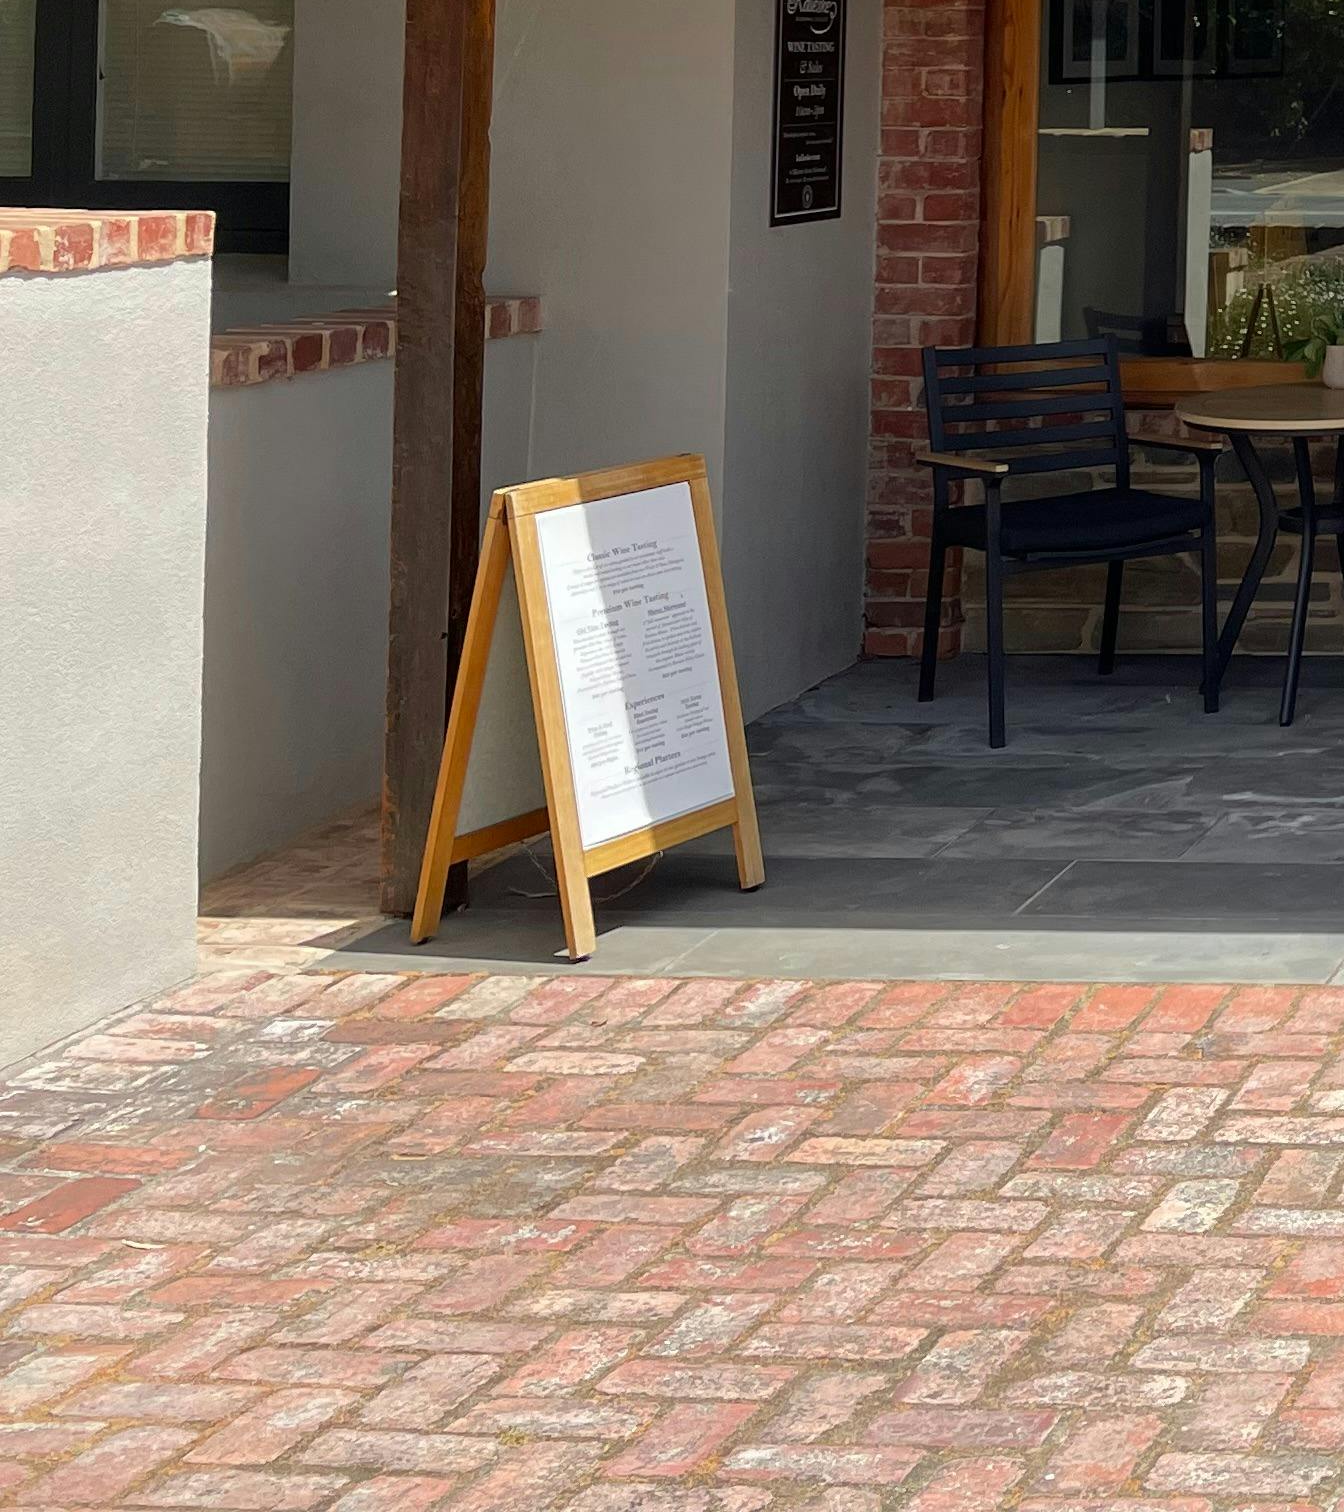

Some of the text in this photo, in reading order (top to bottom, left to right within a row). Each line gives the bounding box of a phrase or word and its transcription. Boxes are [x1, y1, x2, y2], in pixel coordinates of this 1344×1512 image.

[587, 540, 658, 562] Classic Wine Tasting
[592, 603, 623, 618] Premium
[624, 598, 642, 609] Wine
[644, 591, 669, 605] Tasting
[625, 693, 665, 711] Experiences
[655, 751, 681, 765] Platters
